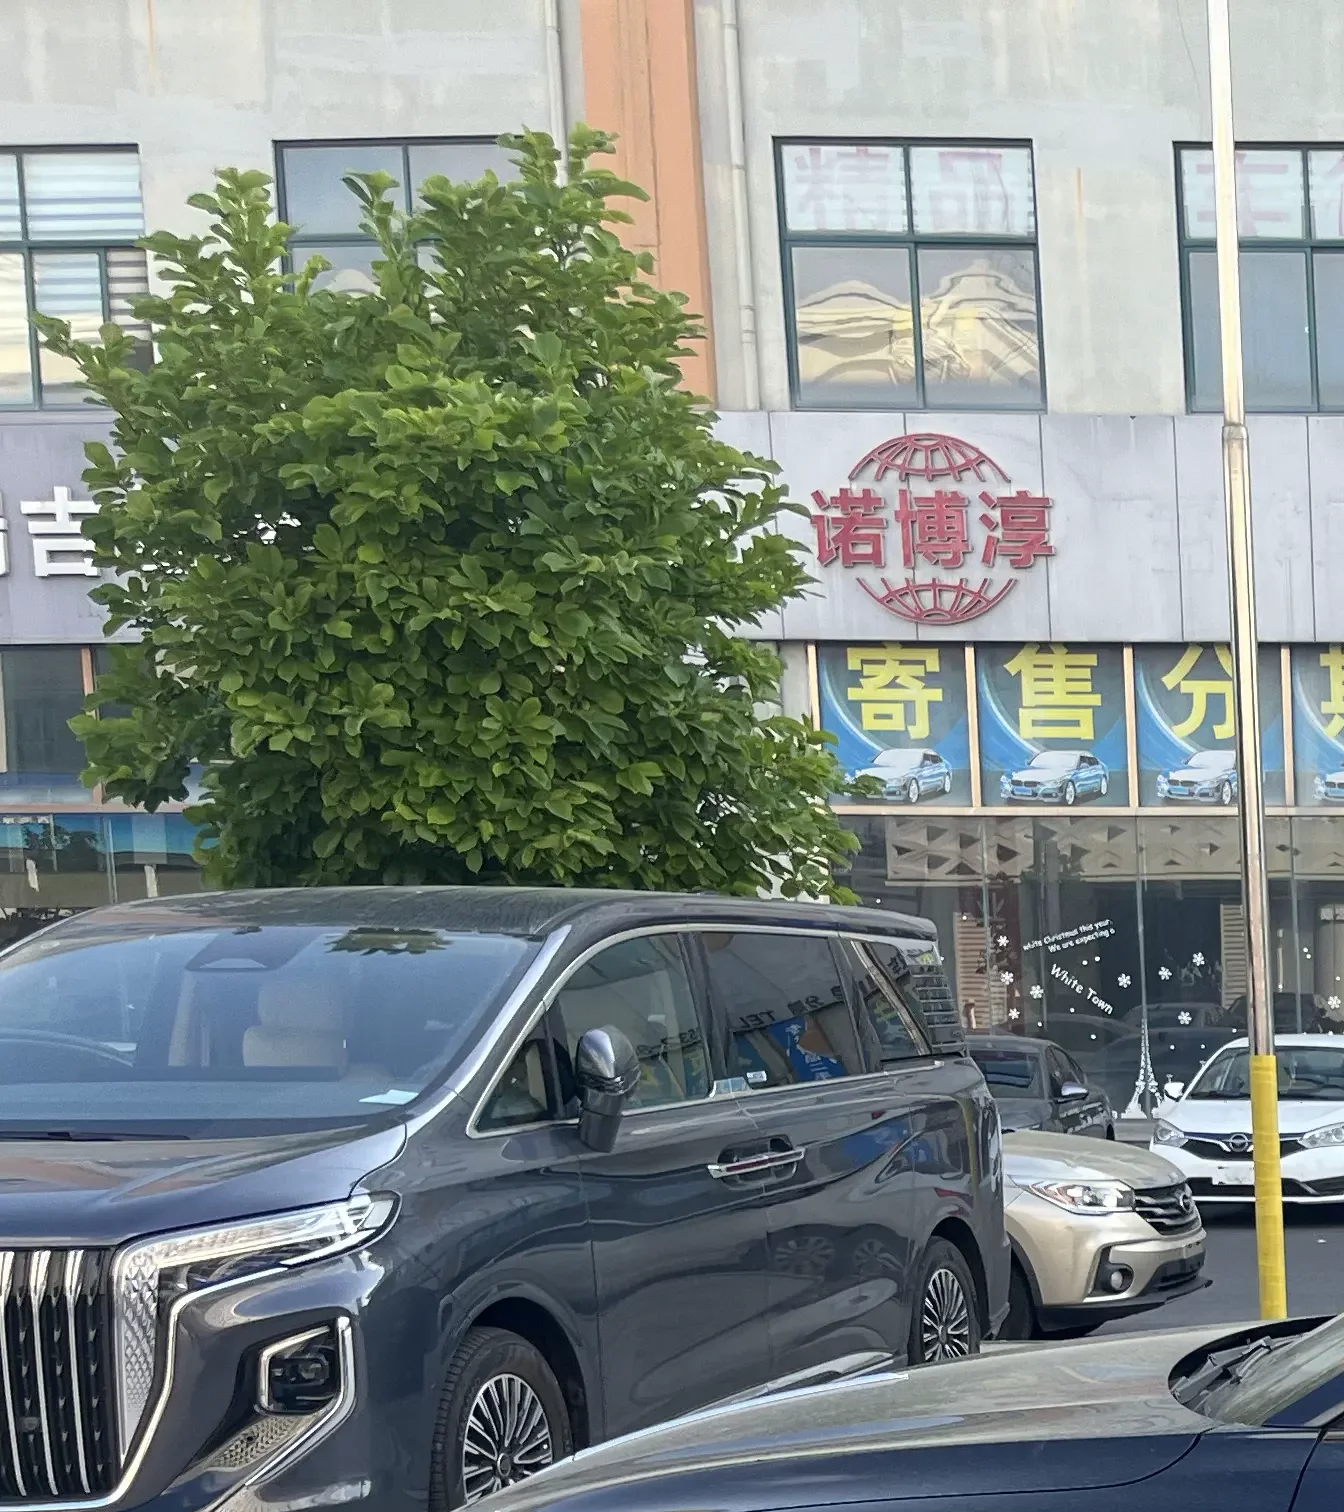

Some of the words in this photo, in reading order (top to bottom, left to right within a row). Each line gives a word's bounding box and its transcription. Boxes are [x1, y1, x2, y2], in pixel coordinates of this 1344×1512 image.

[810, 488, 1056, 569] 诺博淳
[1048, 943, 1062, 953] We
[1050, 963, 1084, 994] White
[1086, 987, 1114, 1015] Town
